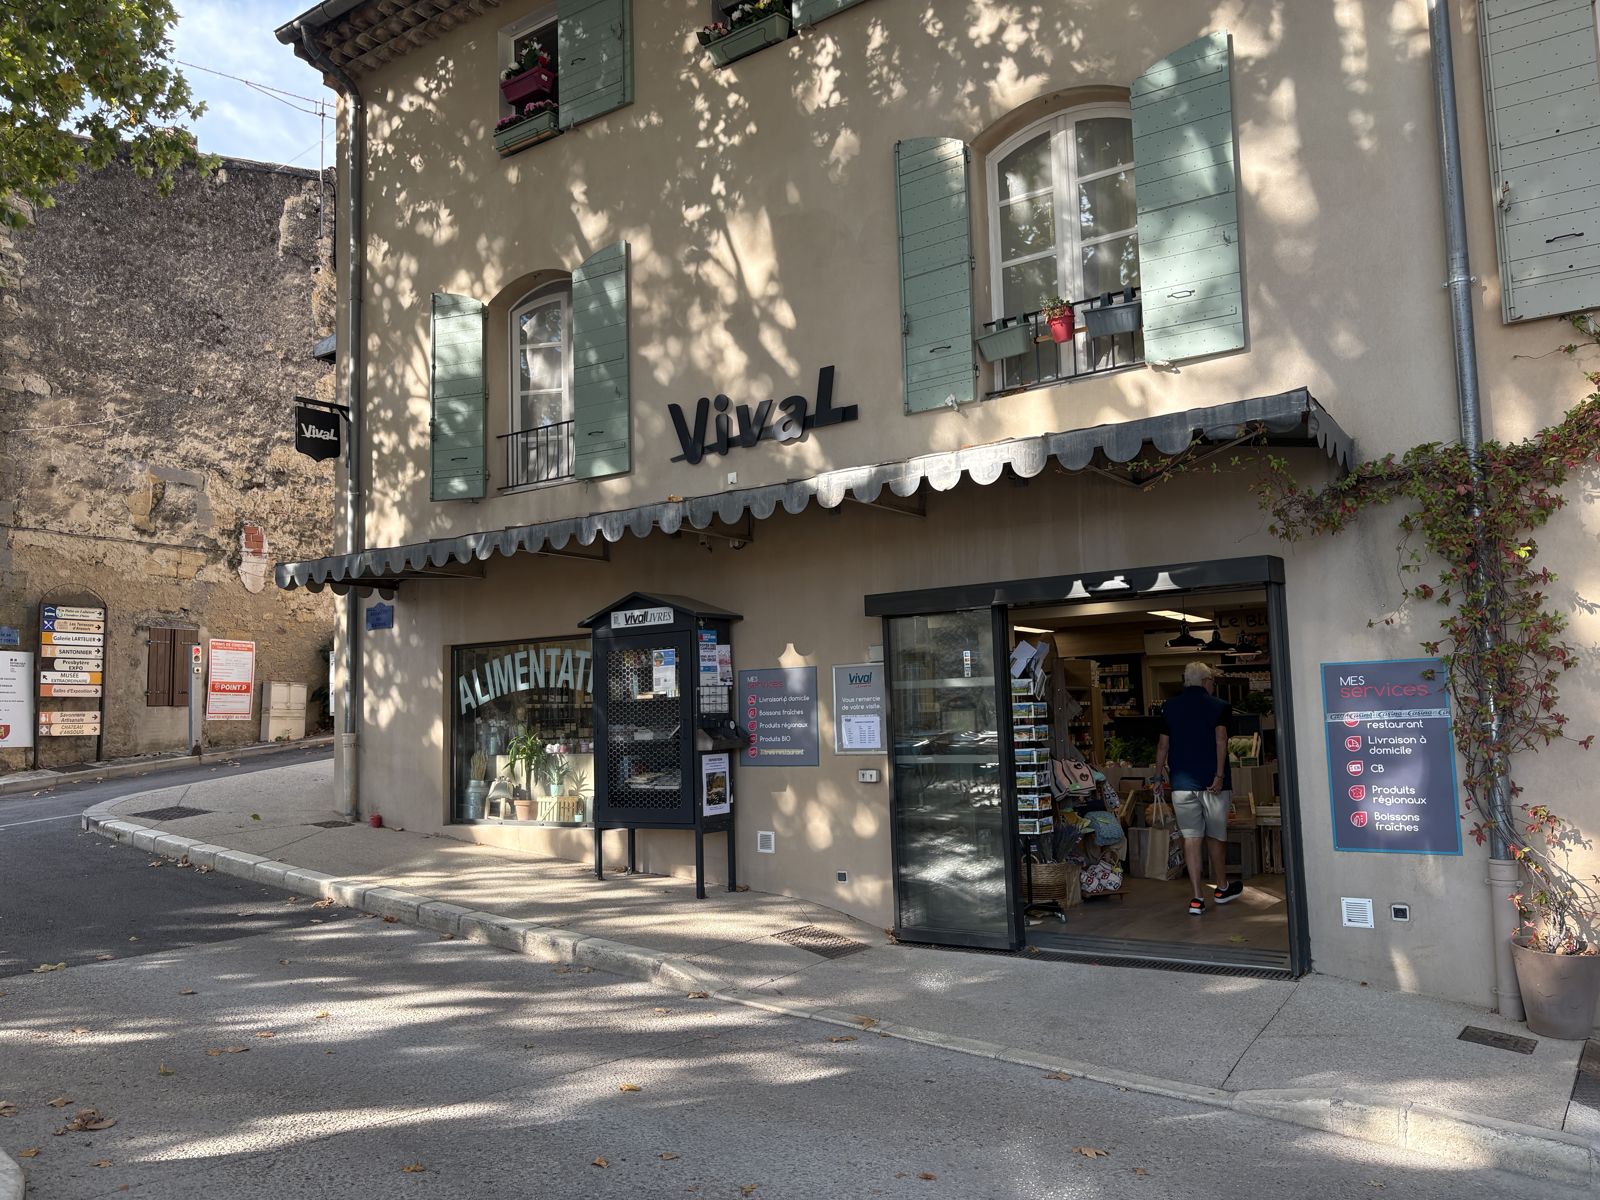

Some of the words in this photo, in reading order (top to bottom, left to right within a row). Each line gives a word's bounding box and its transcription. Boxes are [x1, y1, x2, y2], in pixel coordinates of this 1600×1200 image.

[848, 672, 873, 684] Vival
[1339, 675, 1365, 687] MES
[1340, 682, 1430, 698] services
[1367, 719, 1424, 729] restaurant
[1368, 735, 1417, 745] Livraison
[1420, 735, 1427, 744] à
[1369, 746, 1413, 755] domicile
[1370, 763, 1385, 773] CB
[1371, 784, 1416, 795] Produits
[1372, 795, 1427, 806] régionaux
[1374, 811, 1420, 822] Boissons
[1375, 822, 1420, 832] fraîches
